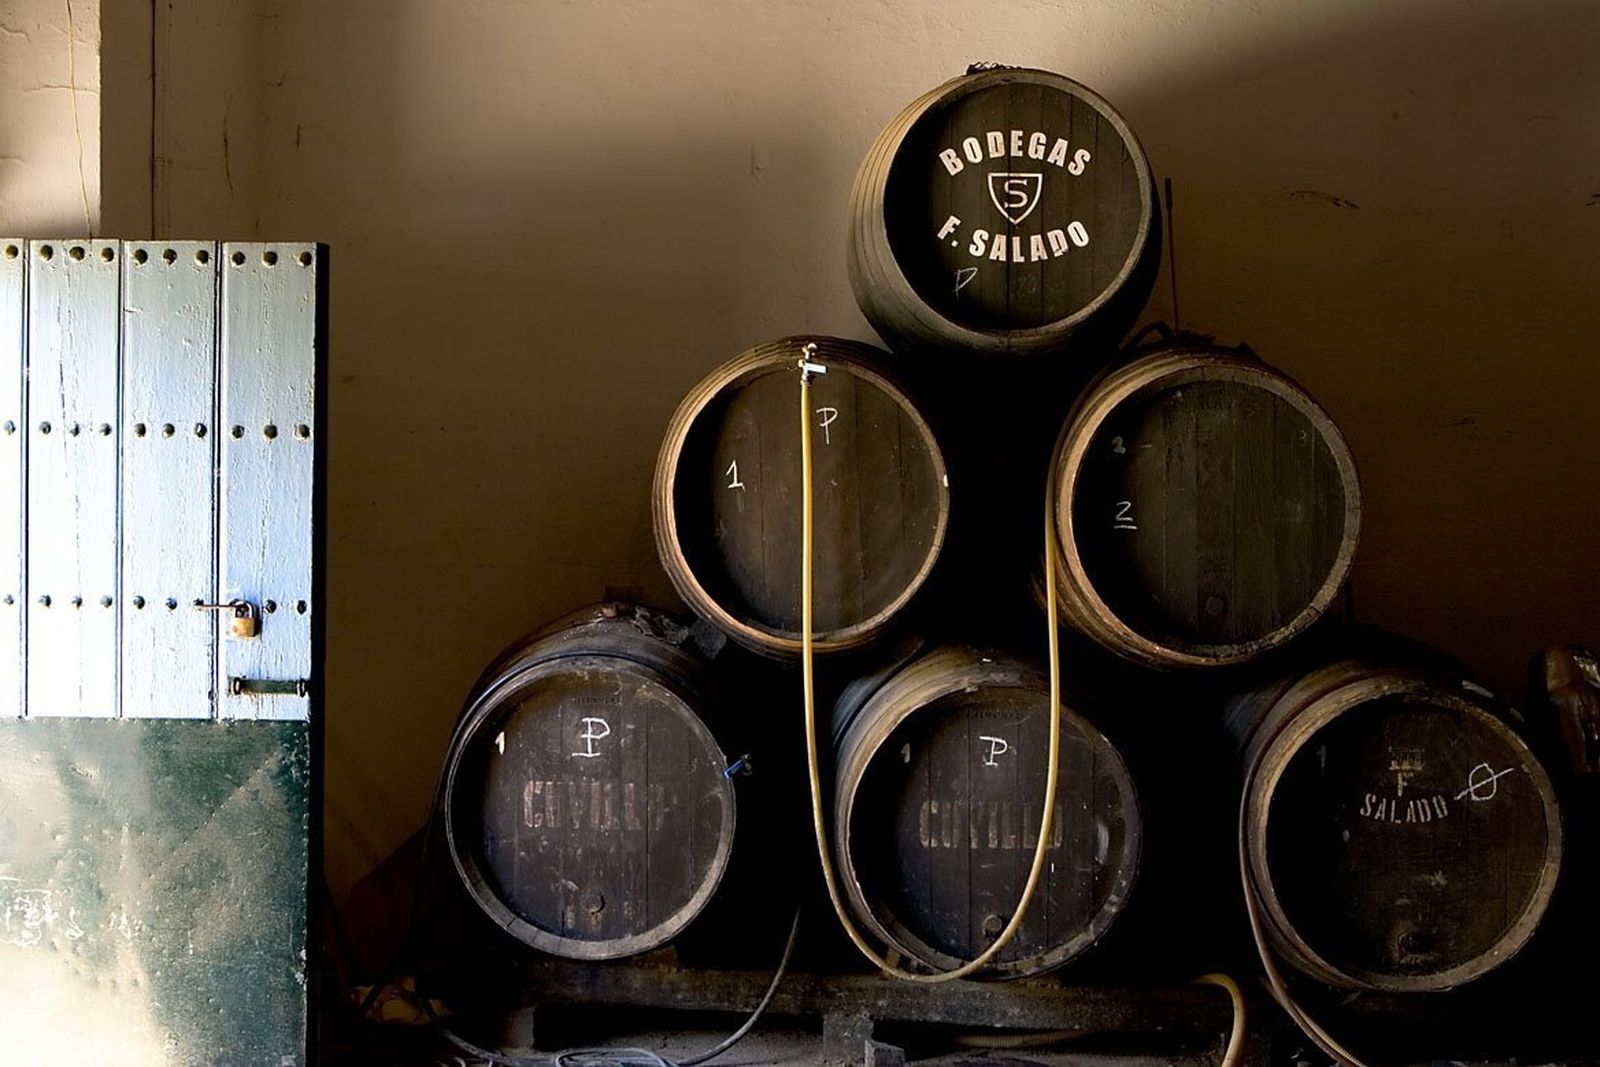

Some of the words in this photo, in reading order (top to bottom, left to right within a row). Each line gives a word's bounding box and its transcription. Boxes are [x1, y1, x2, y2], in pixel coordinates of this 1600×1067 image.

[938, 129, 1092, 177] BODEGAS
[1003, 179, 1029, 209] S
[937, 215, 962, 248] F.
[968, 220, 1090, 263] SALADO
[815, 406, 839, 445] P
[725, 459, 746, 493] 1
[571, 717, 611, 757] P
[978, 735, 1008, 768] P
[1359, 792, 1450, 824] SALADO
